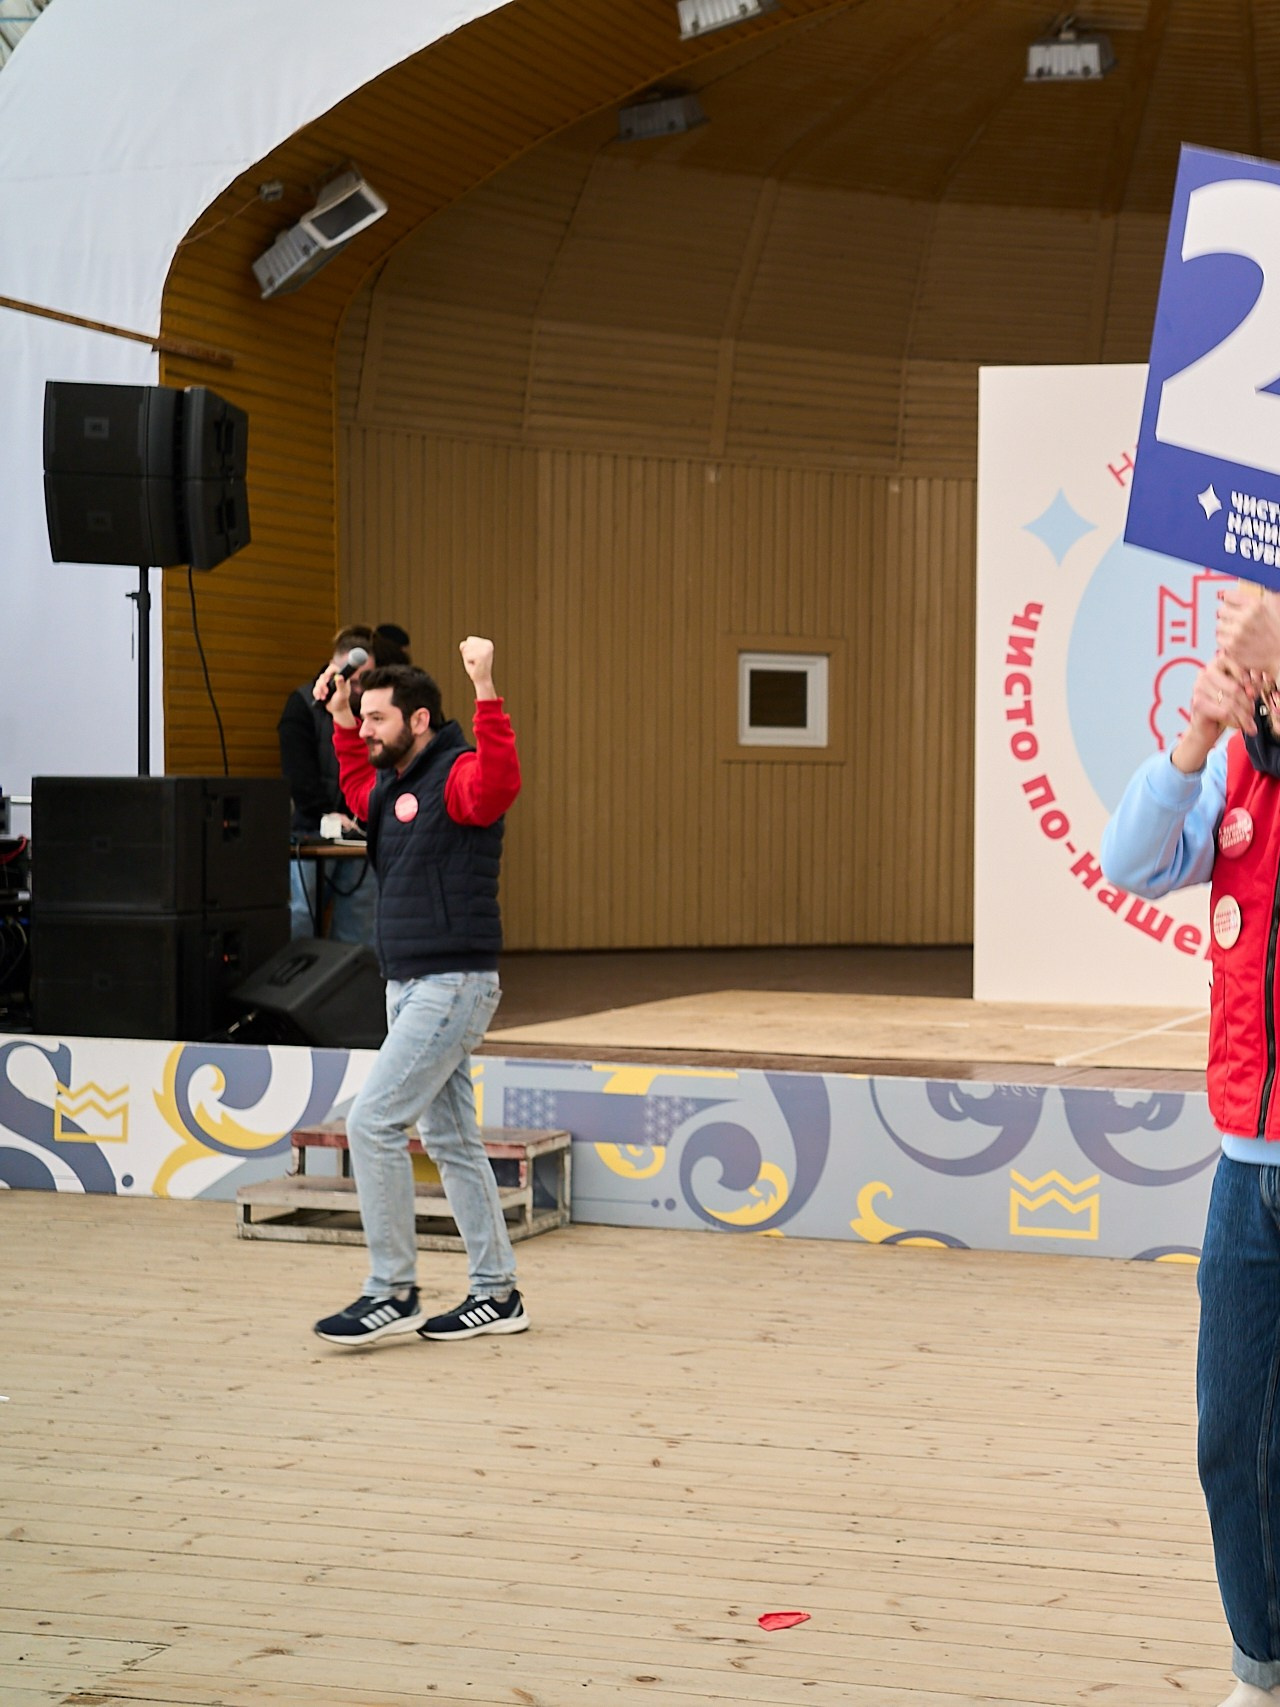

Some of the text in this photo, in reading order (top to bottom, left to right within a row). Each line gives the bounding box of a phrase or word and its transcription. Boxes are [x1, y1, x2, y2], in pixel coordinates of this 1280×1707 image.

[1224, 531, 1237, 554] В
[1004, 601, 1213, 961] чисто по-наше
